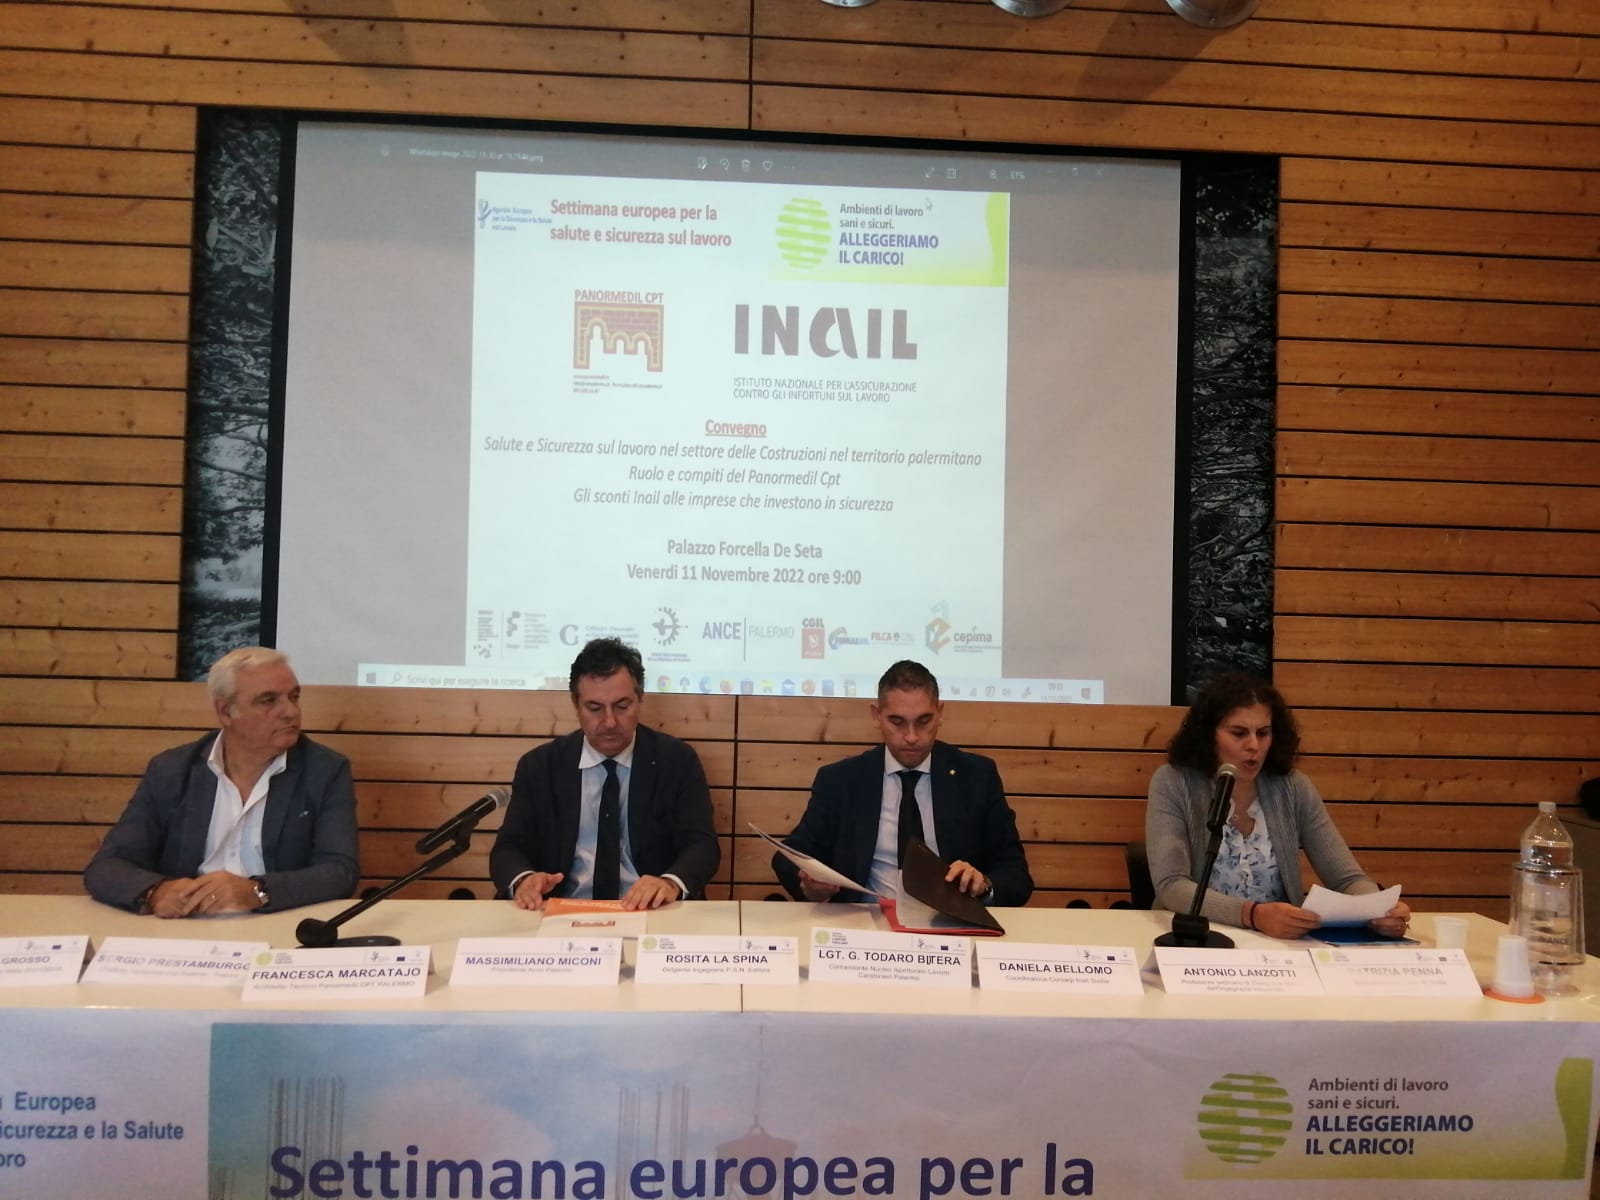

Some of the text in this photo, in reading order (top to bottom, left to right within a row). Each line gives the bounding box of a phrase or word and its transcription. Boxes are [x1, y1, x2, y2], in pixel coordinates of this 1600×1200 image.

[550, 199, 718, 222] Settimana europea per la
[840, 203, 924, 216] Ambienti di lavoro
[840, 218, 895, 230] sani e sicuri.
[550, 225, 732, 247] salute e sicurezza sul lavoro
[839, 232, 939, 249] ALLEGGERIAMO
[839, 250, 904, 266] IL CARICO!
[574, 289, 664, 304] PANORMEDIL CPT
[734, 304, 917, 360] INAIL
[733, 377, 917, 393] ISTITUTO NAZIONALE PER L'ASSICURAZIONE
[733, 388, 890, 403] CONTRO GLI INFORTUNI SUL LAVORO
[705, 419, 767, 437] Convegno
[483, 435, 982, 467] Salute e Sicurezza sul lavoro nel settore delle Costruzioni nel territorio palermitano
[629, 465, 841, 488] Ruolo e compiti del Panormedil Cpt
[574, 487, 893, 511] Gli sconti Inail alle imprese che investono in sicurezza
[667, 539, 822, 558] Palazzo Forcella De Seta
[681, 565, 697, 580] 11
[701, 566, 769, 582] Novembre
[772, 568, 804, 583] 2022
[807, 571, 829, 584] ore
[833, 569, 861, 584] 9:00
[702, 621, 795, 640] ANCE PALERMO
[802, 617, 825, 628] CGIL
[953, 626, 993, 644] cepima
[443, 678, 457, 687] per
[1, 956, 50, 965] GROSSO
[465, 956, 601, 966] MASSIMILIANO MICONI
[666, 954, 768, 964] ROSITA LA SPINA
[818, 949, 845, 960] LGT.
[848, 951, 860, 961] G.
[864, 952, 914, 963] TODARO
[252, 970, 334, 980] FRANCESCA
[338, 967, 421, 978] MARCATAJO
[1000, 962, 1112, 975] DANIELA BELLOMO
[1184, 967, 1296, 977] ANTONIO LANZOTTI
[1403, 968, 1443, 976] PENNA
[1308, 1077, 1449, 1092] Ambienti di lavoro
[15, 1091, 96, 1115] Europea
[1307, 1096, 1399, 1110] sani e sicuri.
[84, 1125, 95, 1140] e
[101, 1120, 118, 1140] la
[124, 1120, 184, 1140] Salute
[1306, 1114, 1473, 1132] ALLEGGERIAMO
[1305, 1137, 1414, 1156] IL CARICO!
[269, 1142, 1094, 1200] Settimana europea per la
